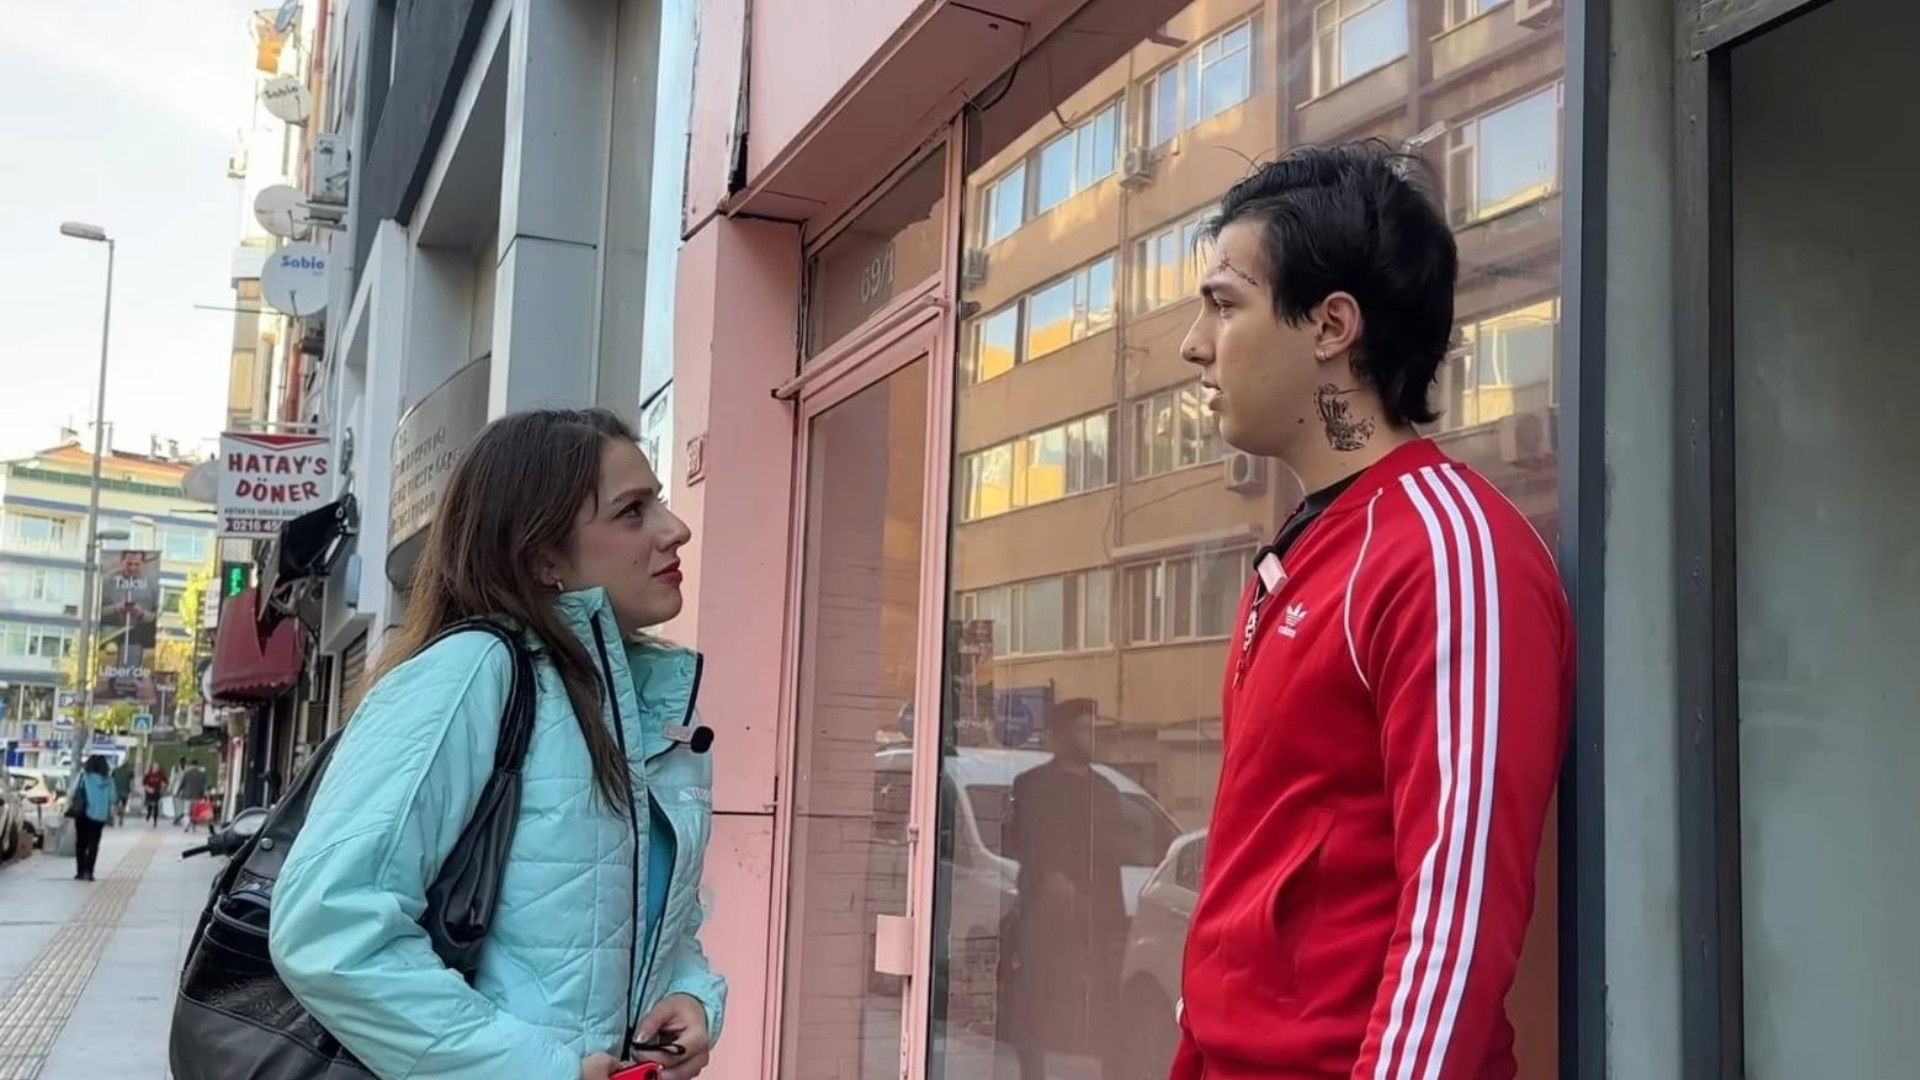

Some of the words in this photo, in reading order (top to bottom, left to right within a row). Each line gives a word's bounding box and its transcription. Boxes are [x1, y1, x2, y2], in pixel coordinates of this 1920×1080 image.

[860, 248, 894, 303] 69/1
[228, 453, 327, 475] HATAY'S
[235, 478, 319, 502] DÖNER
